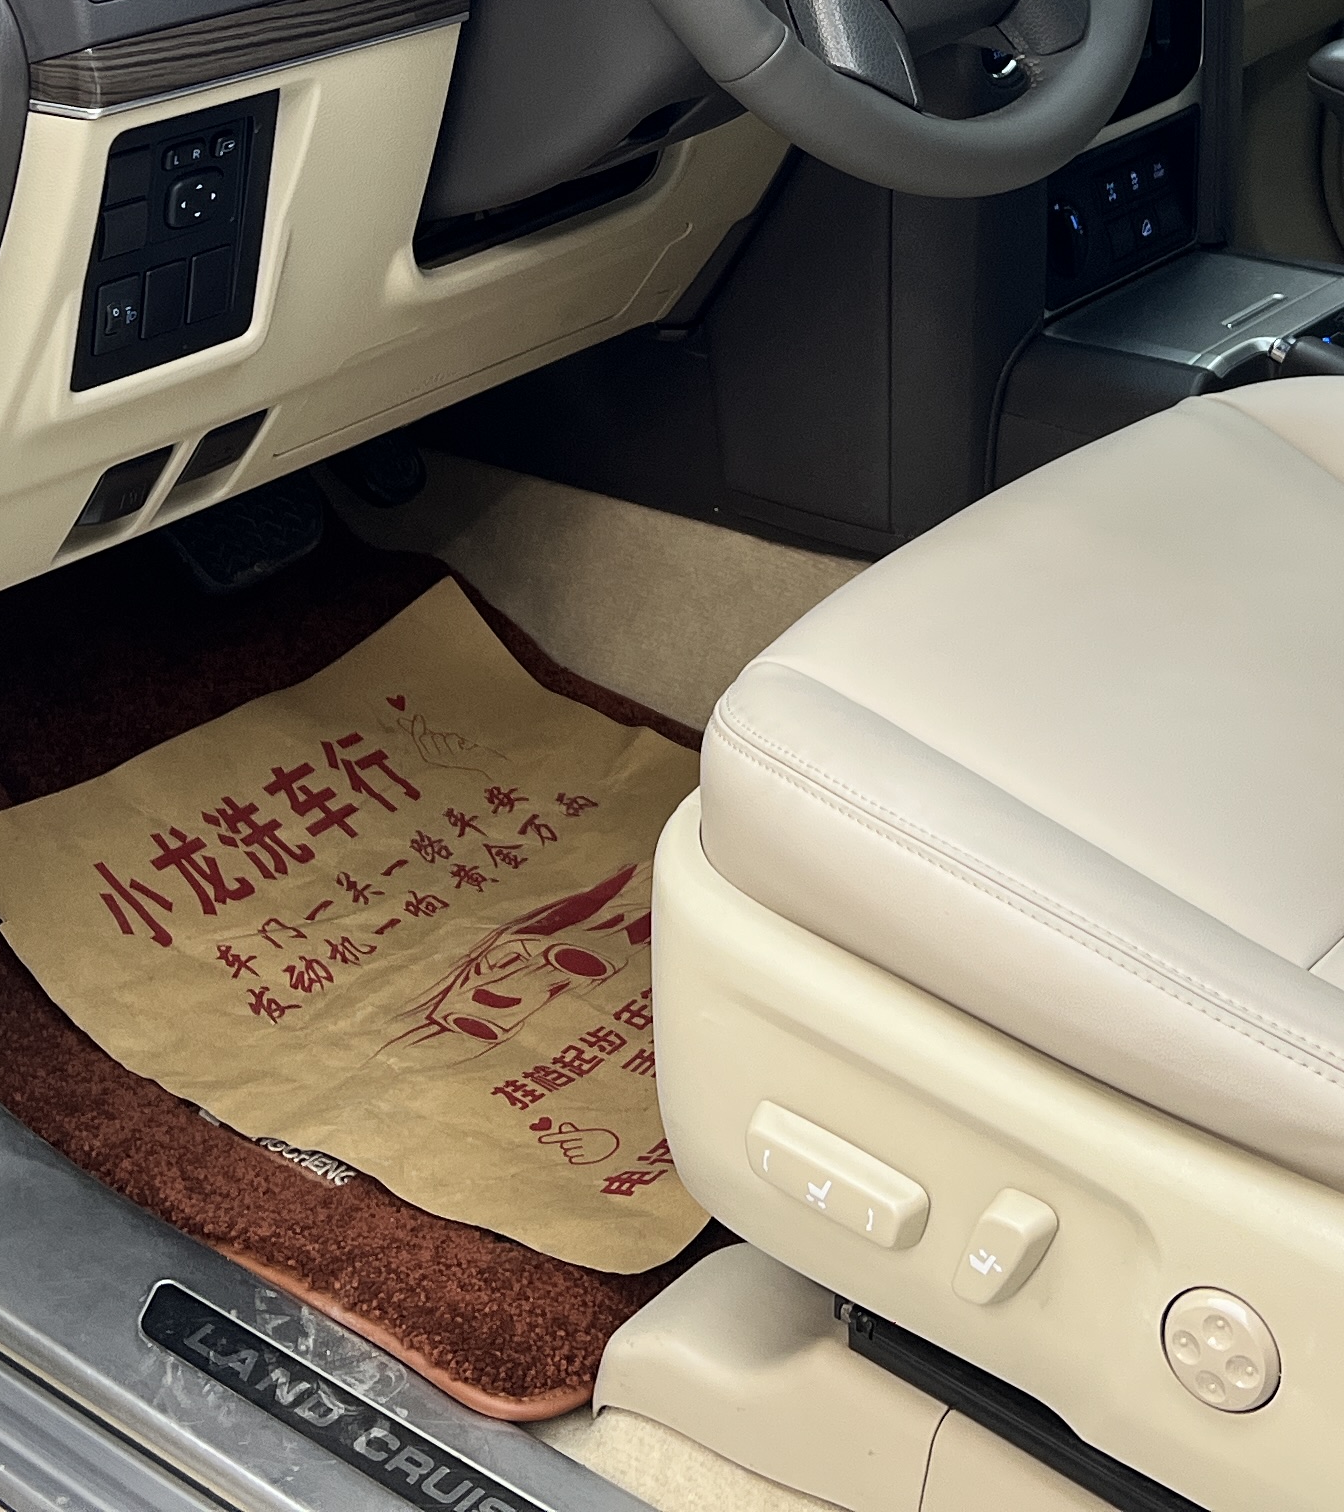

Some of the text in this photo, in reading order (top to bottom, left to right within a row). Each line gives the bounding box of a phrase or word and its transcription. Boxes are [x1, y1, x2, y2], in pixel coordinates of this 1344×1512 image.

[173, 148, 201, 165] L R
[93, 731, 421, 948] 小龙洗车行
[183, 1322, 346, 1428] LAND
